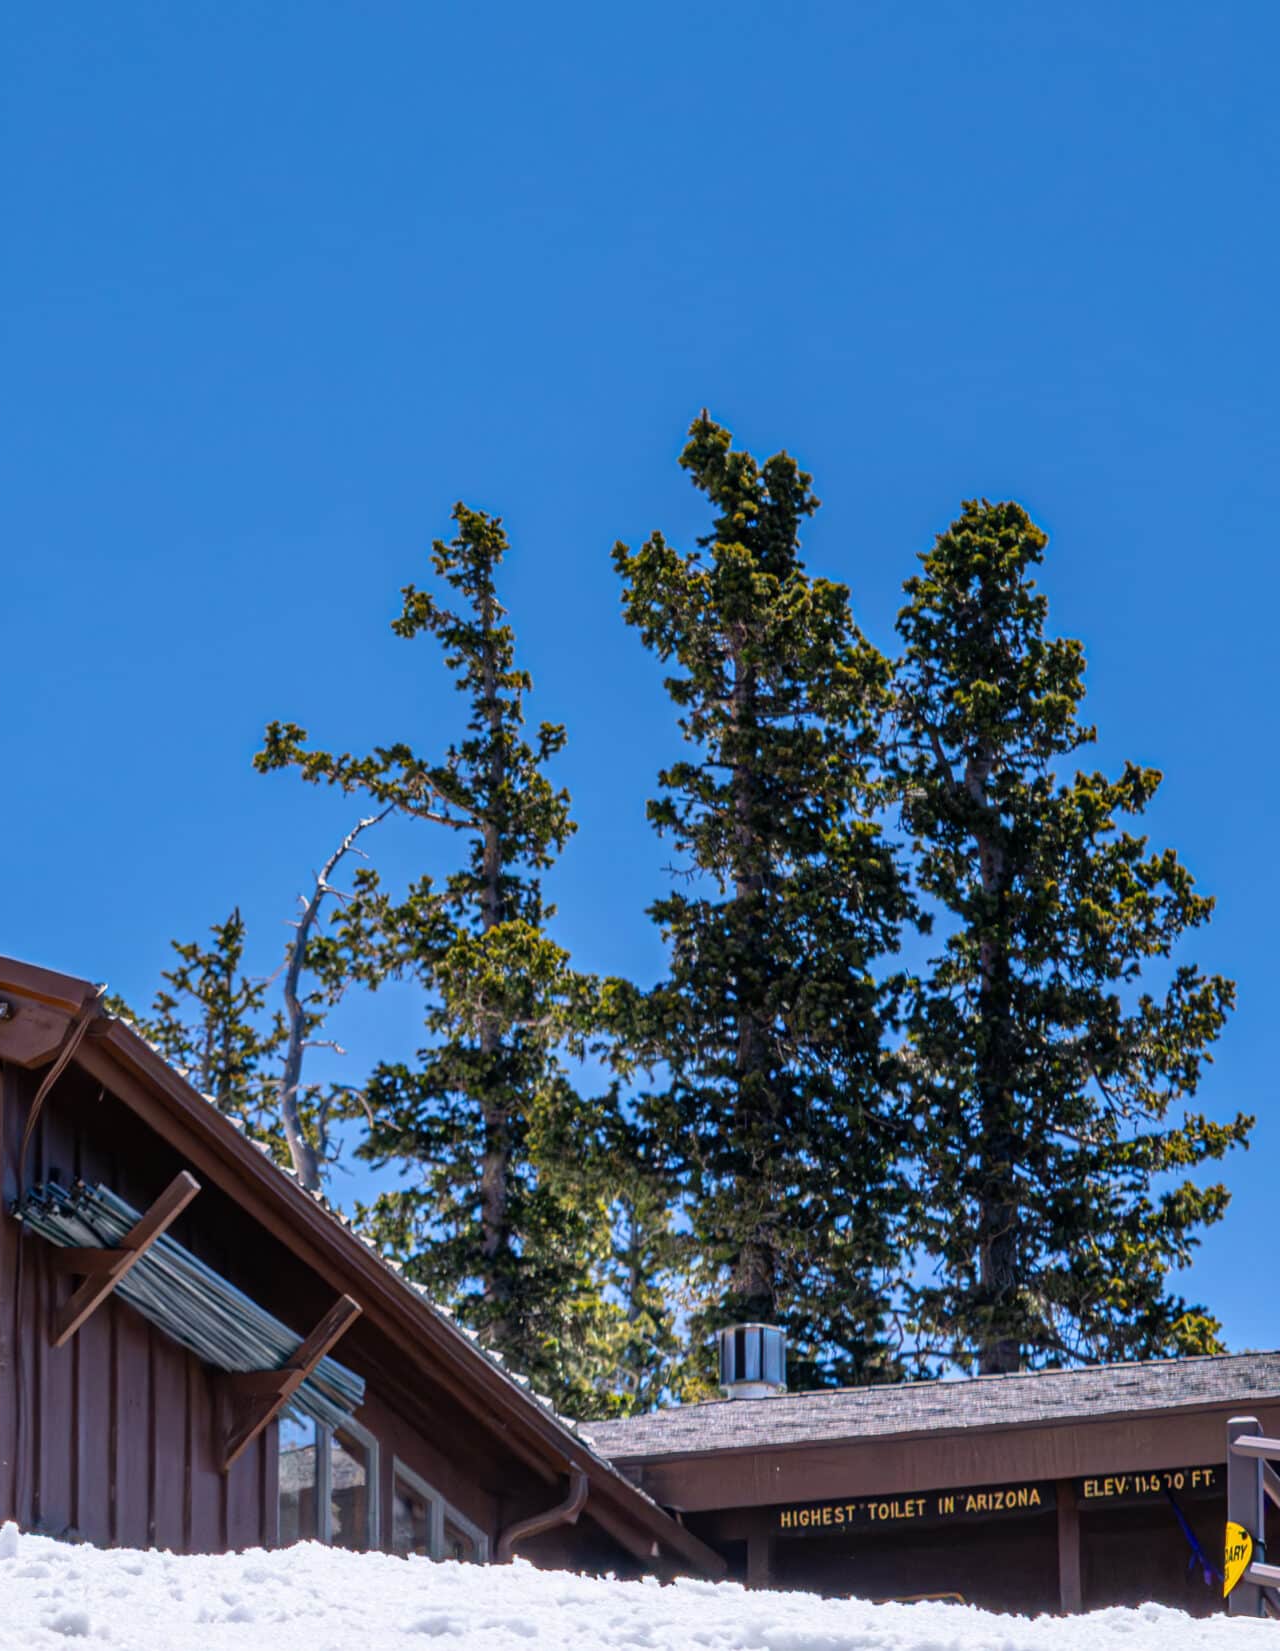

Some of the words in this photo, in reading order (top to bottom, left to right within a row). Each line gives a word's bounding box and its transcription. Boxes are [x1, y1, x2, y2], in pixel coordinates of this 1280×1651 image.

[1191, 1470, 1216, 1488] FT.
[780, 1504, 856, 1528] HIGHEST
[868, 1499, 927, 1520] TOILET
[938, 1496, 954, 1514] IN
[965, 1487, 1042, 1513] ARIZONA
